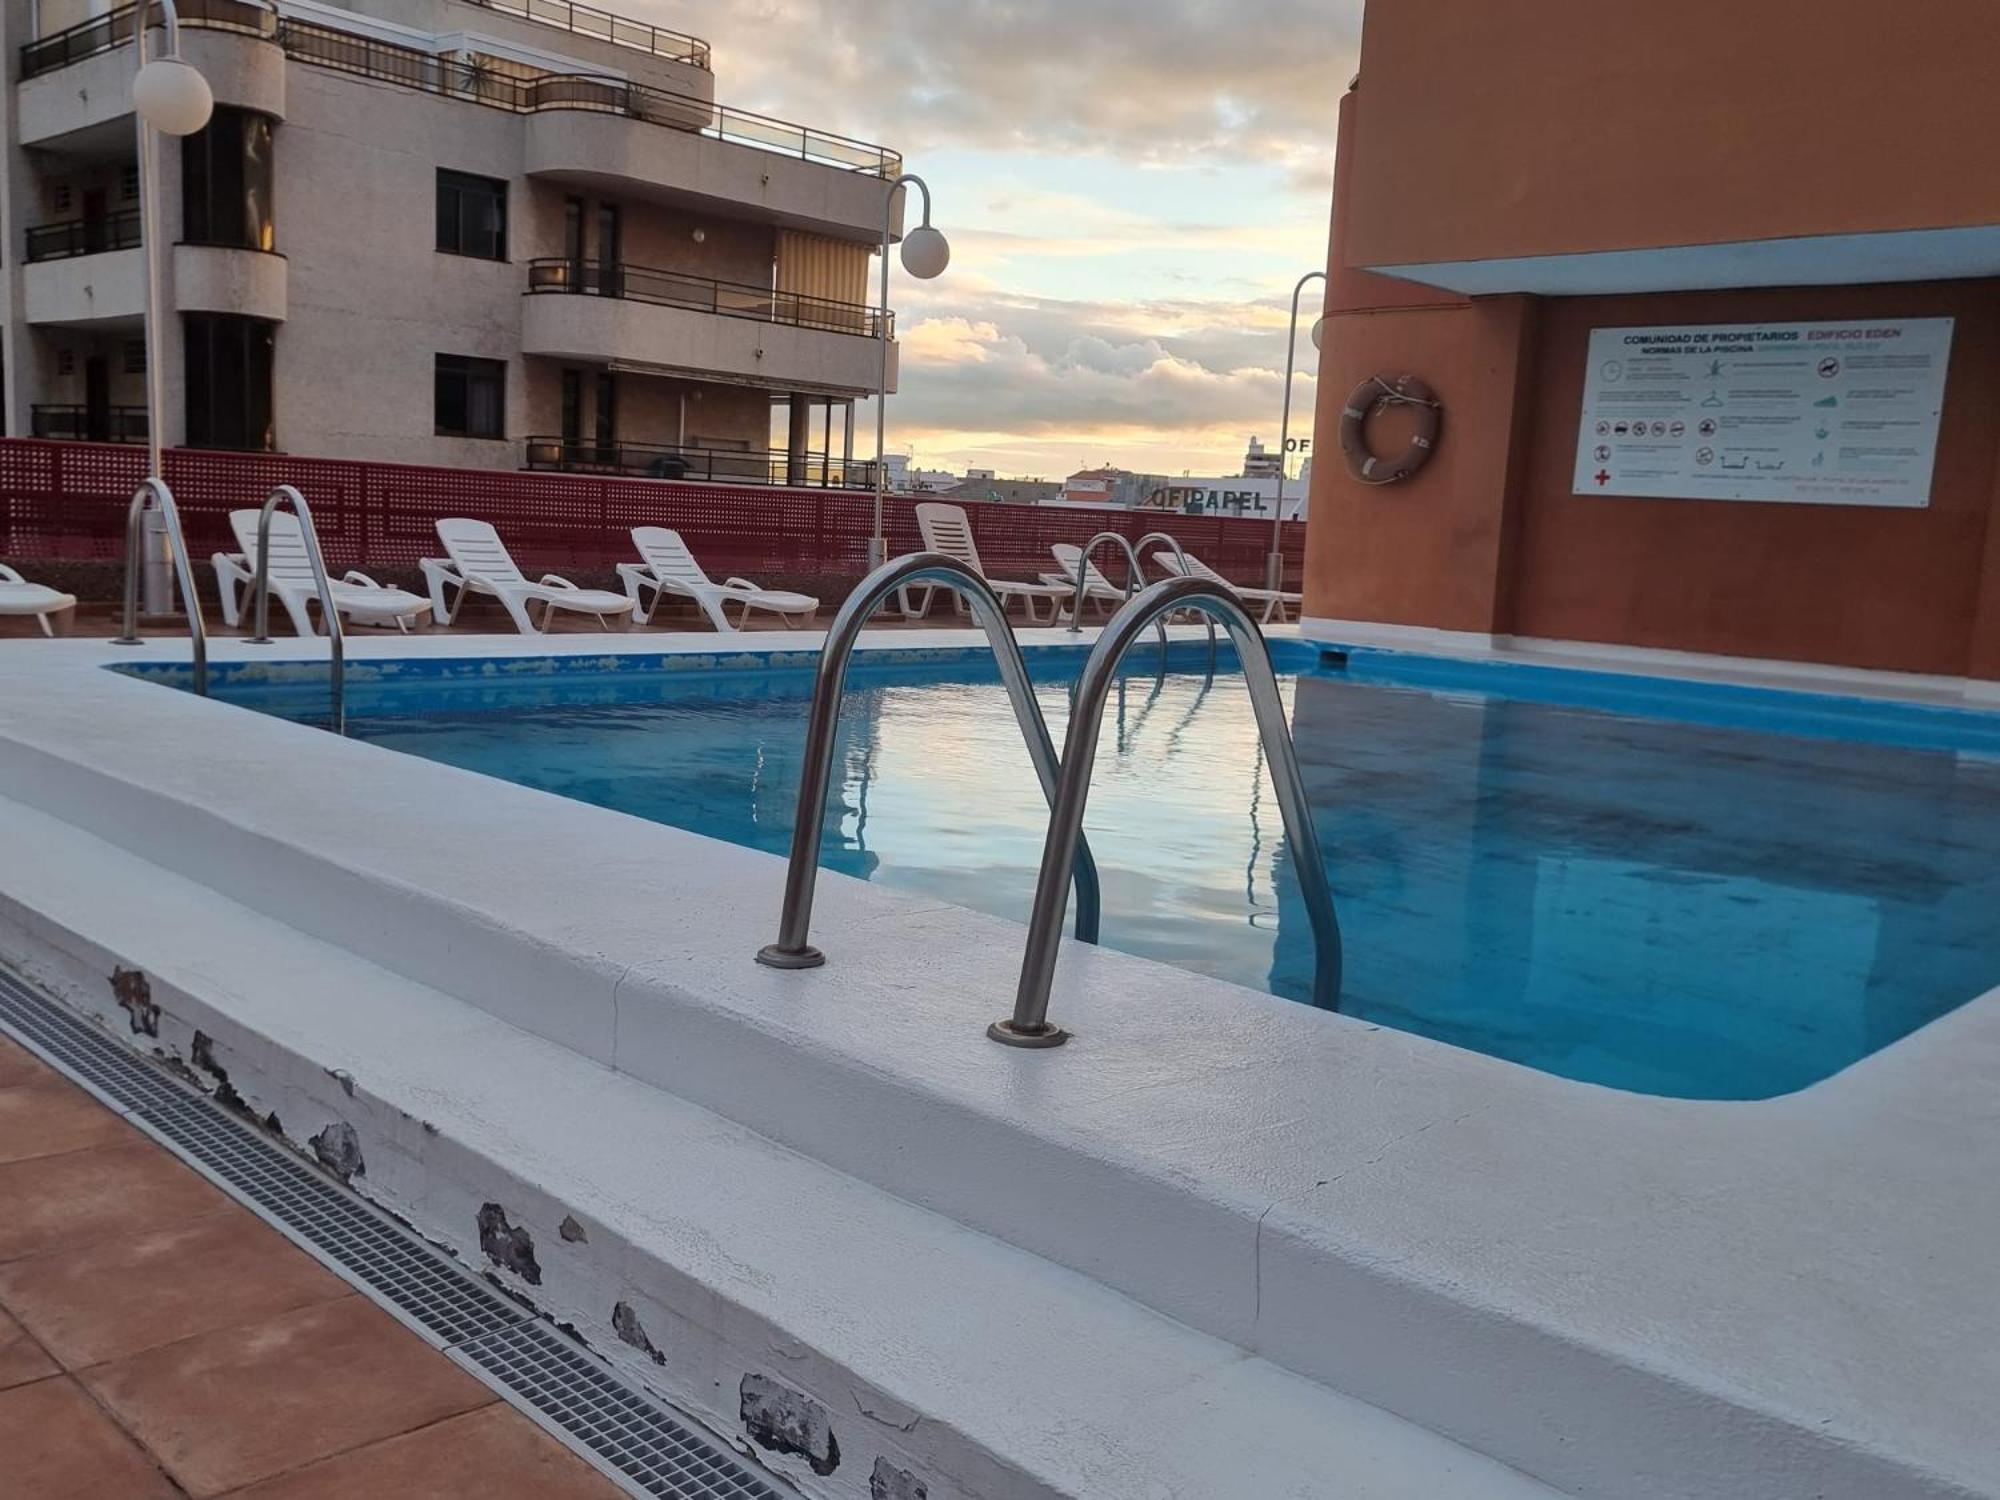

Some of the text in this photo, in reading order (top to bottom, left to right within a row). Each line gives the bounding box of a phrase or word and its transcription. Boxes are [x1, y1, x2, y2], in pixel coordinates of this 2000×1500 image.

[1623, 328, 1902, 344] COMUNIDAD DE PROPIETARIOS EDIFICIO EDEN
[1641, 346, 1682, 354] NORMAS
[1684, 346, 1697, 354] DE
[1699, 345, 1712, 353] LA
[1714, 345, 1754, 353] PISCINA
[1151, 489, 1267, 511] OFIPAPEL
